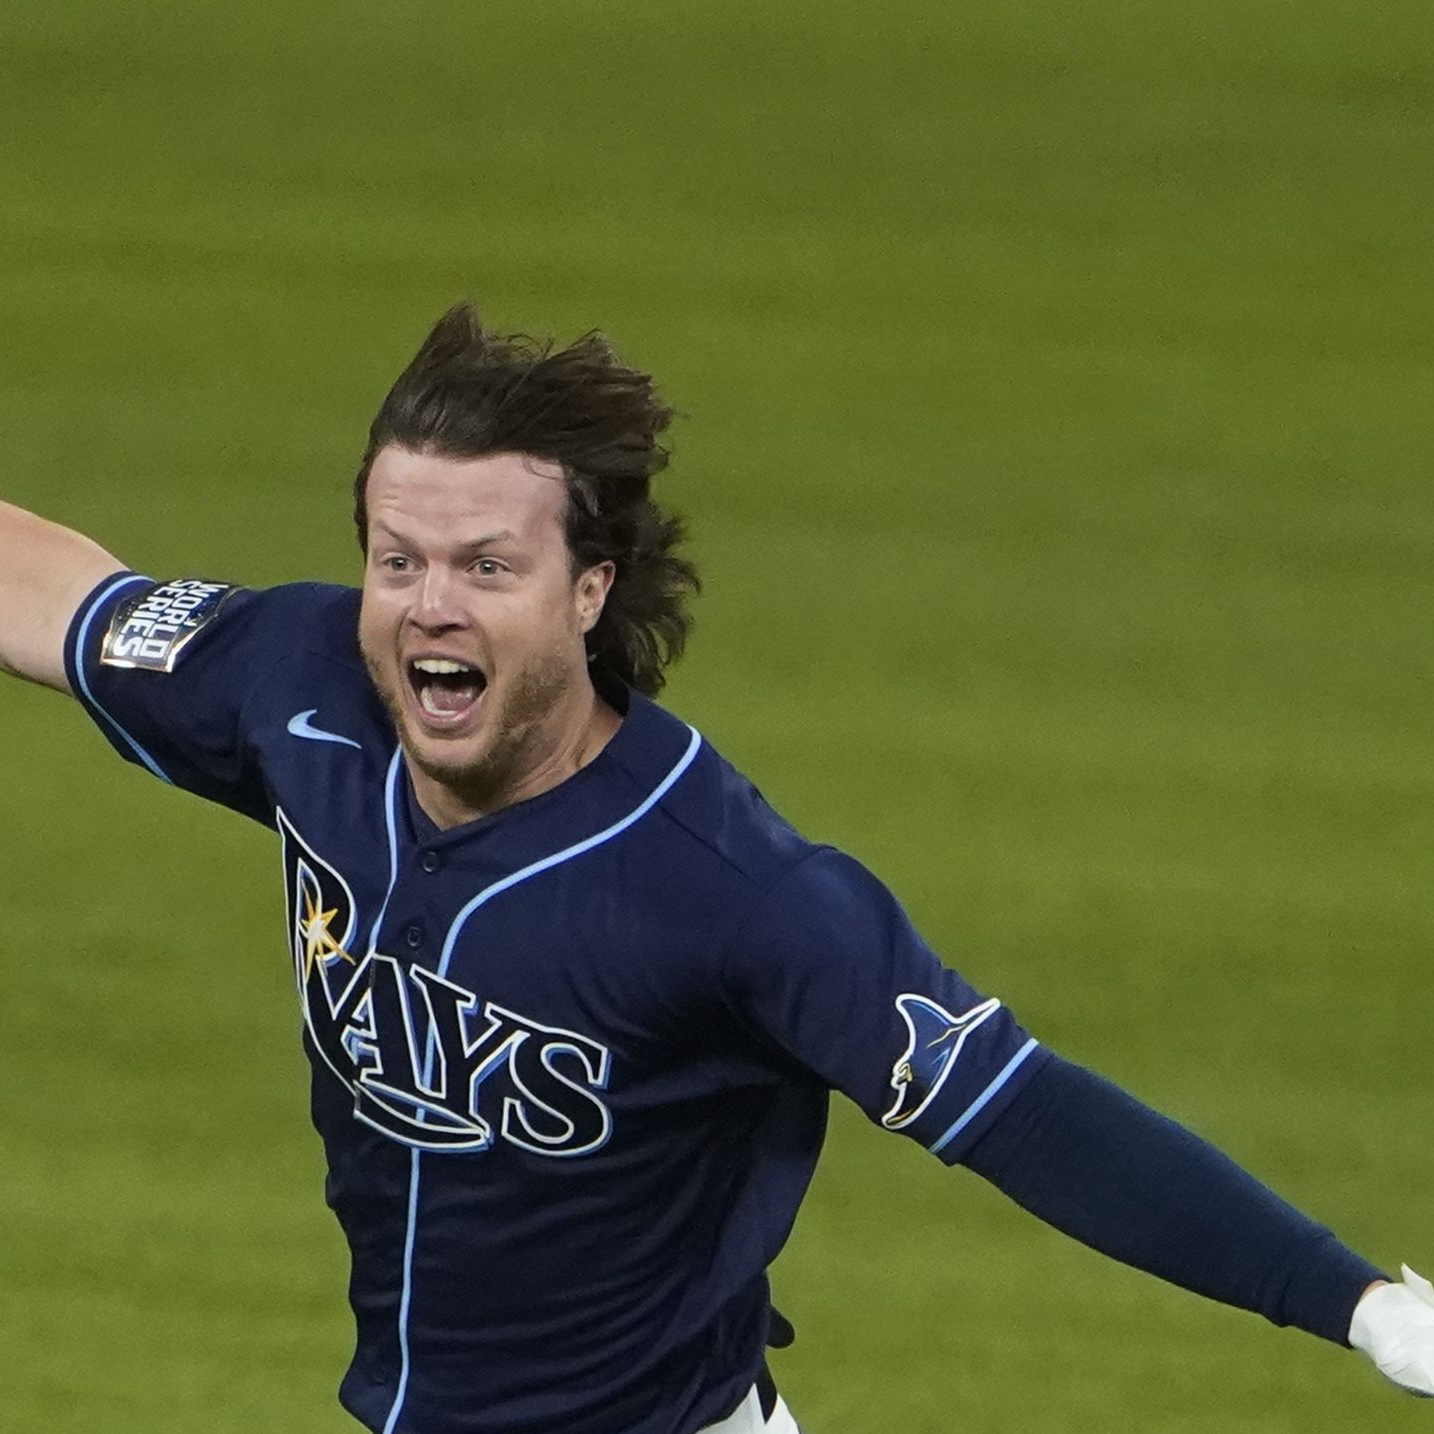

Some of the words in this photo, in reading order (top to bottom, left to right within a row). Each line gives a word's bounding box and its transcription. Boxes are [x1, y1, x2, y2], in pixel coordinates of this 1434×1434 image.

[112, 579, 203, 657] SERIES
[139, 583, 230, 659] WORLD
[275, 805, 613, 1157] RAYS
